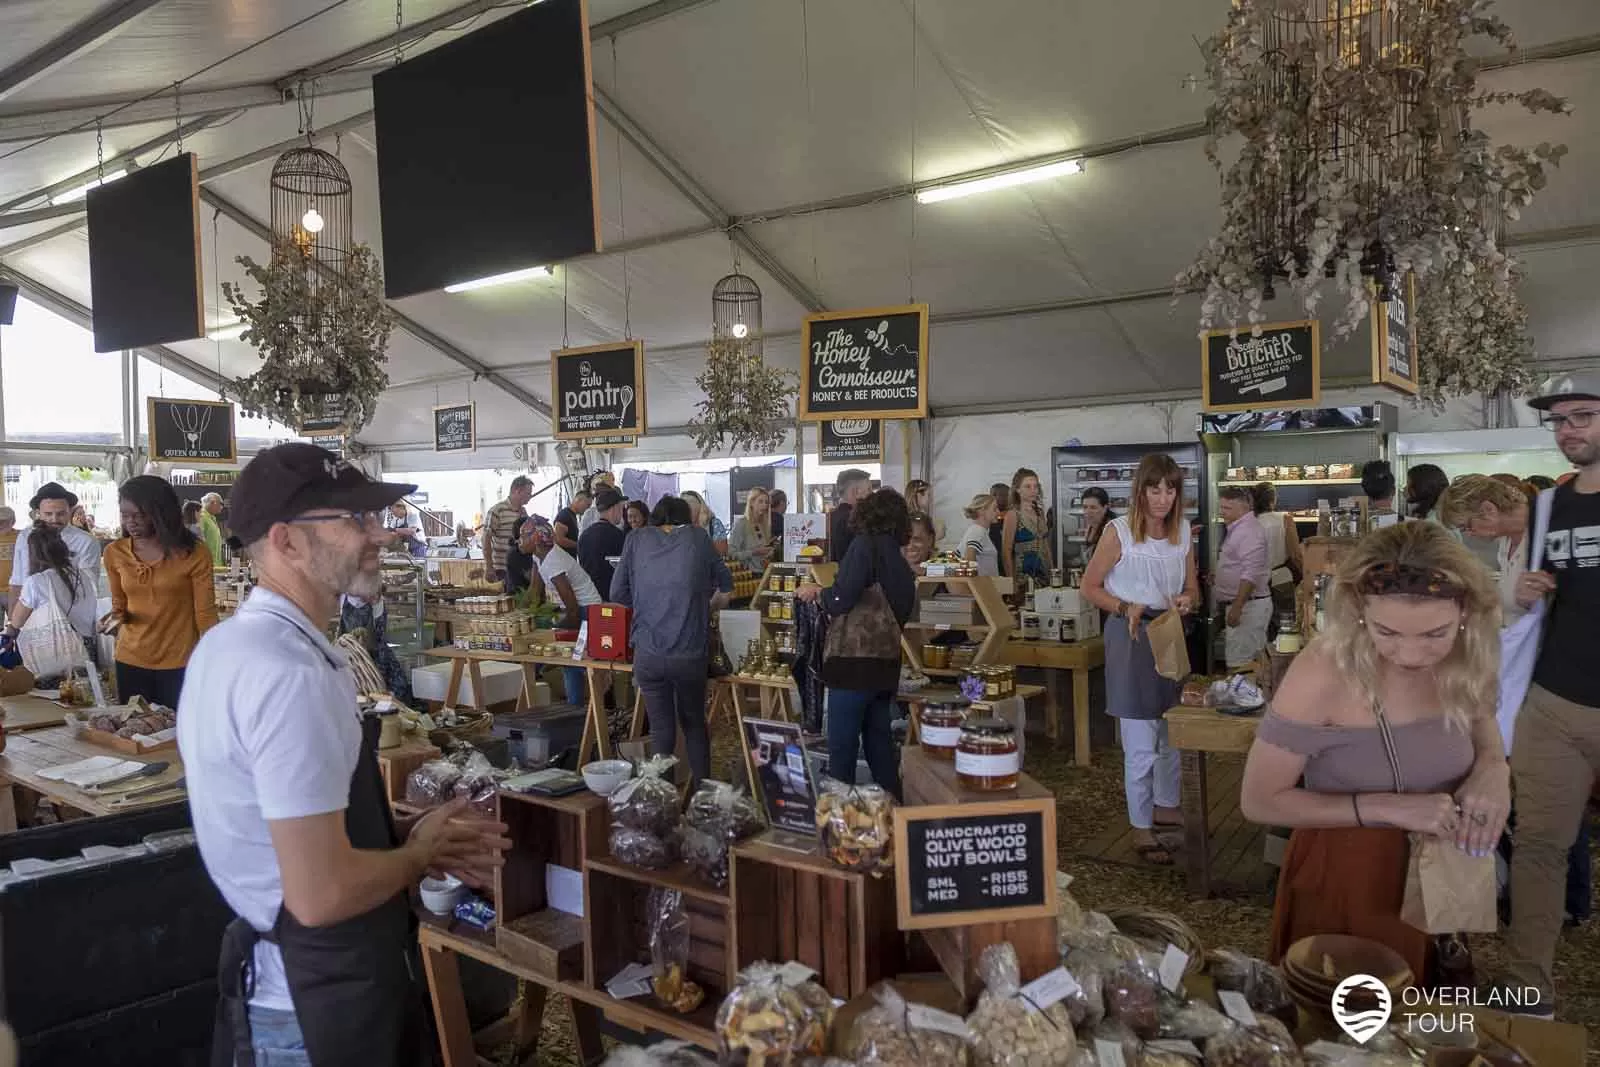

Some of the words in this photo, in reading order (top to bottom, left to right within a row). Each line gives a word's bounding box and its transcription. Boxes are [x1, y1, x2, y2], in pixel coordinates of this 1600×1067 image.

[827, 328, 854, 348] The
[812, 340, 871, 370] Honey
[1225, 333, 1296, 370] BUTCHER
[580, 371, 602, 387] zulu
[819, 366, 917, 388] Connoisseur
[812, 391, 842, 402] HONEY
[844, 391, 853, 401] &
[854, 390, 868, 400] BEE
[871, 386, 917, 399] PRODUCTS
[164, 449, 188, 457] QUEEN
[925, 823, 1027, 840] HANDCRAFTED
[925, 838, 973, 853] OLIVE
[976, 835, 1027, 851] WOOD
[926, 853, 962, 868] NUT
[965, 848, 1027, 865] BOWLS
[927, 877, 957, 889] SML
[927, 889, 959, 901] MED
